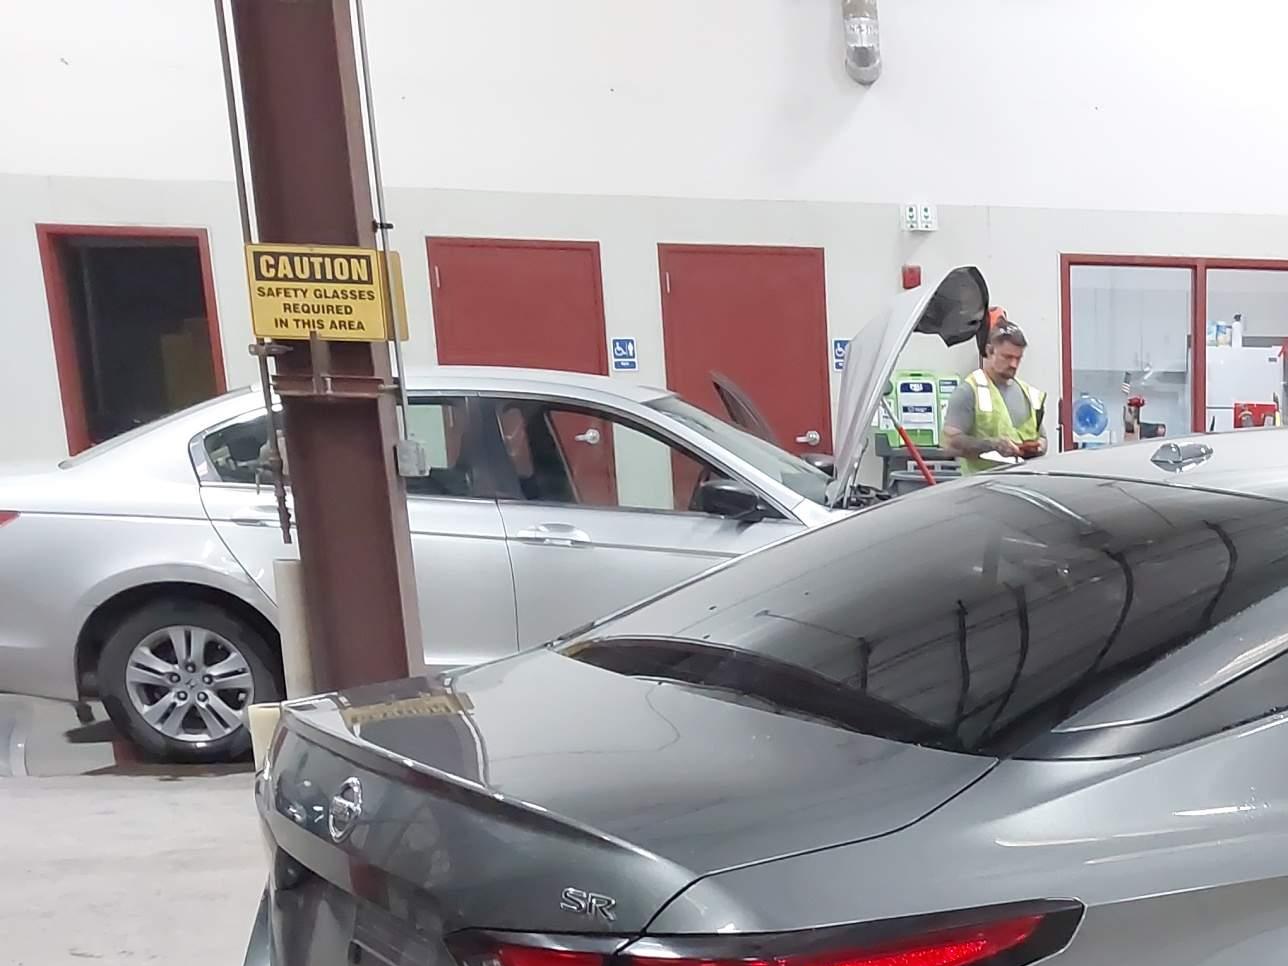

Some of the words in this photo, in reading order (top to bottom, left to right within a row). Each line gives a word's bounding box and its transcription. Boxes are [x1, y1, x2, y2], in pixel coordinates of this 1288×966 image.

[259, 254, 369, 281] CAUTION
[257, 286, 308, 298] SAFETY
[313, 288, 375, 301] GLASSES
[283, 303, 353, 315] REQUIRED
[274, 318, 288, 329] IN
[293, 319, 325, 330] THIS
[329, 320, 365, 331] AREA
[560, 887, 616, 921] SR
